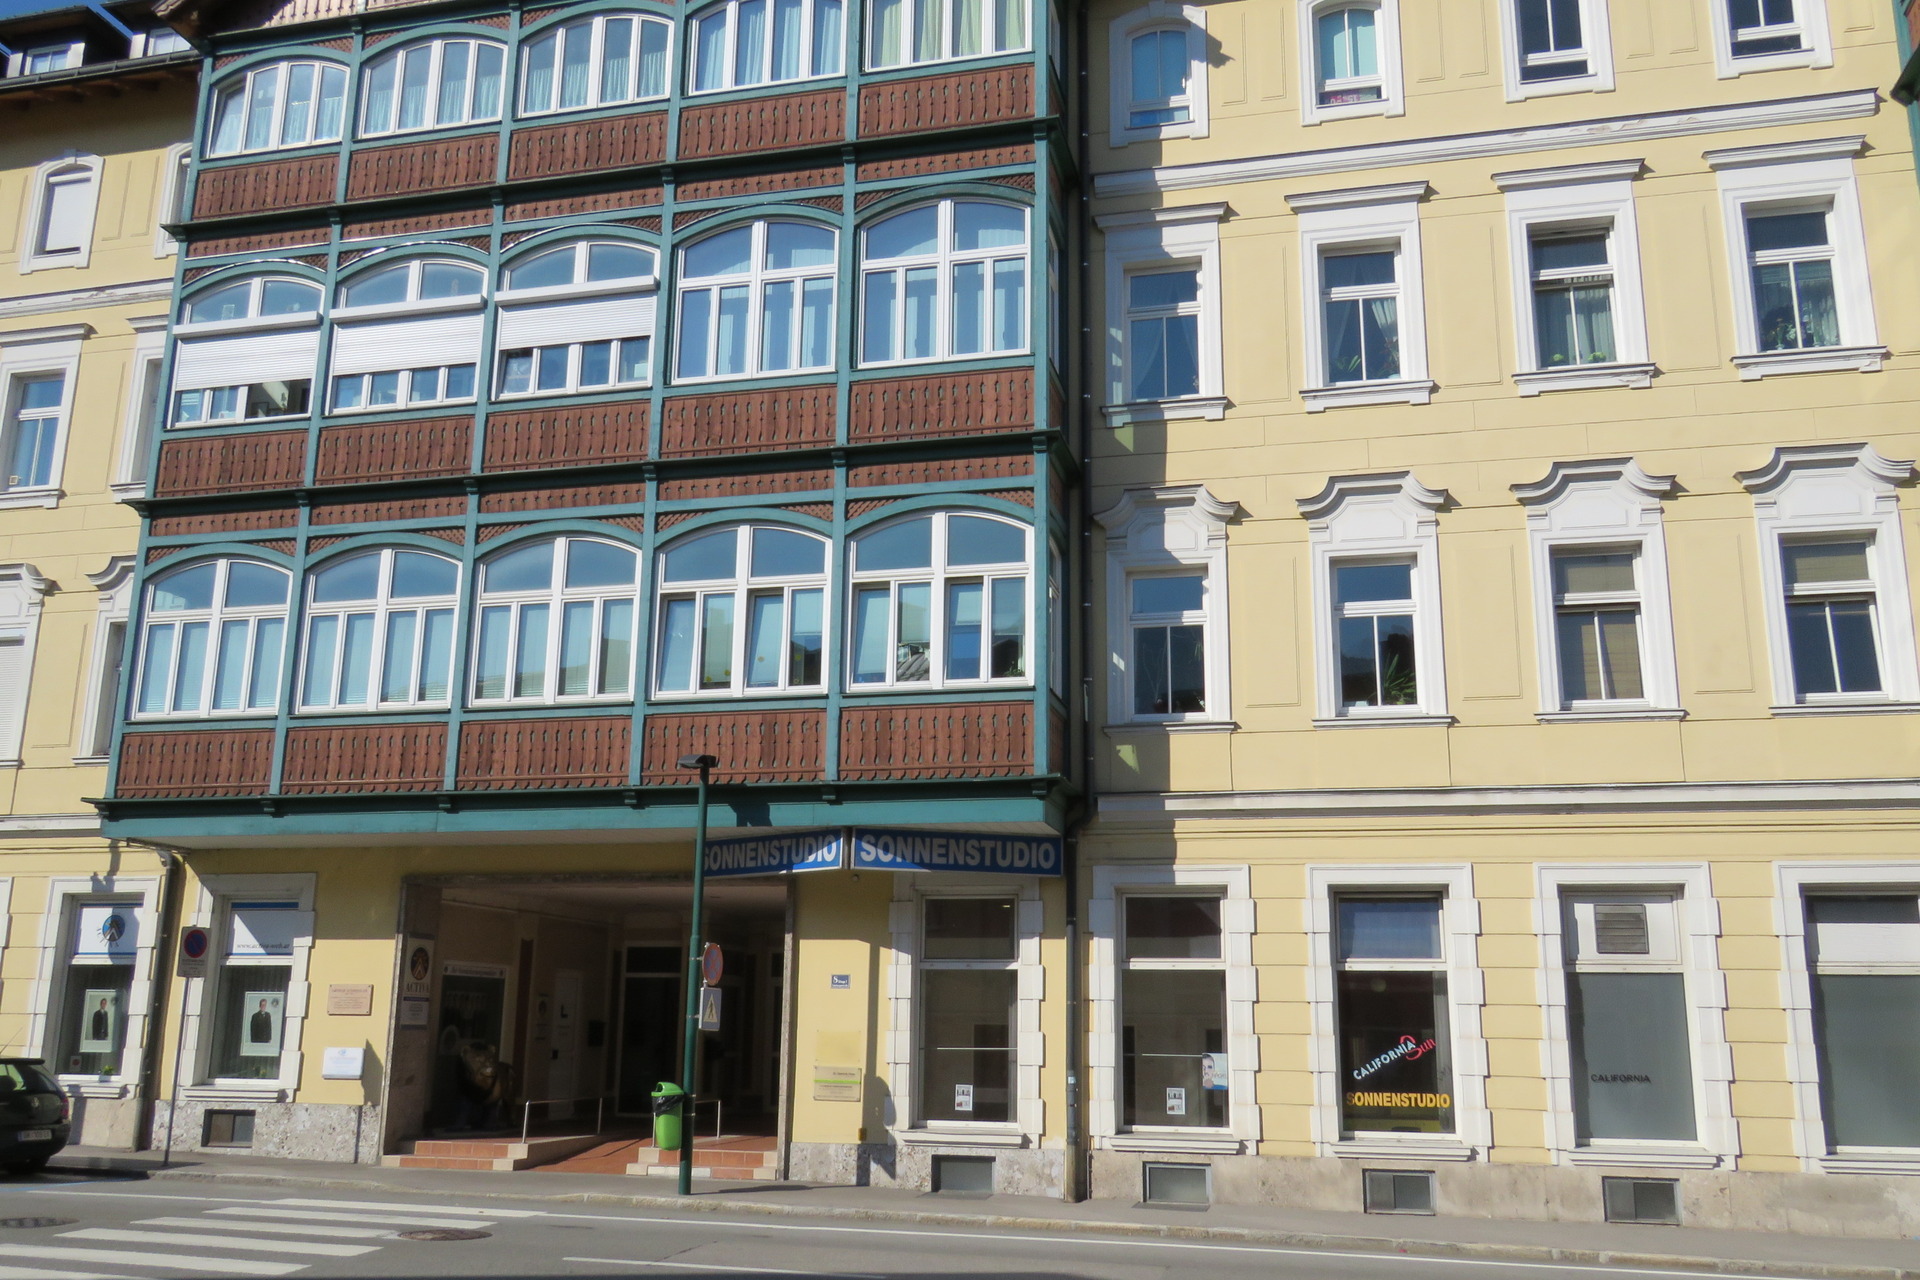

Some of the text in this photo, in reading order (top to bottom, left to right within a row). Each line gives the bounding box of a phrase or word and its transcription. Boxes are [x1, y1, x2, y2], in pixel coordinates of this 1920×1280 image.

[704, 834, 837, 871] SONNENSTUDIO
[859, 834, 1056, 870] SONNENSTUDIO
[1353, 1035, 1436, 1080] CALIFORNIA Sun
[1590, 1074, 1652, 1084] CALIFORNIA
[1346, 1092, 1451, 1108] SONNENSTUDIO
